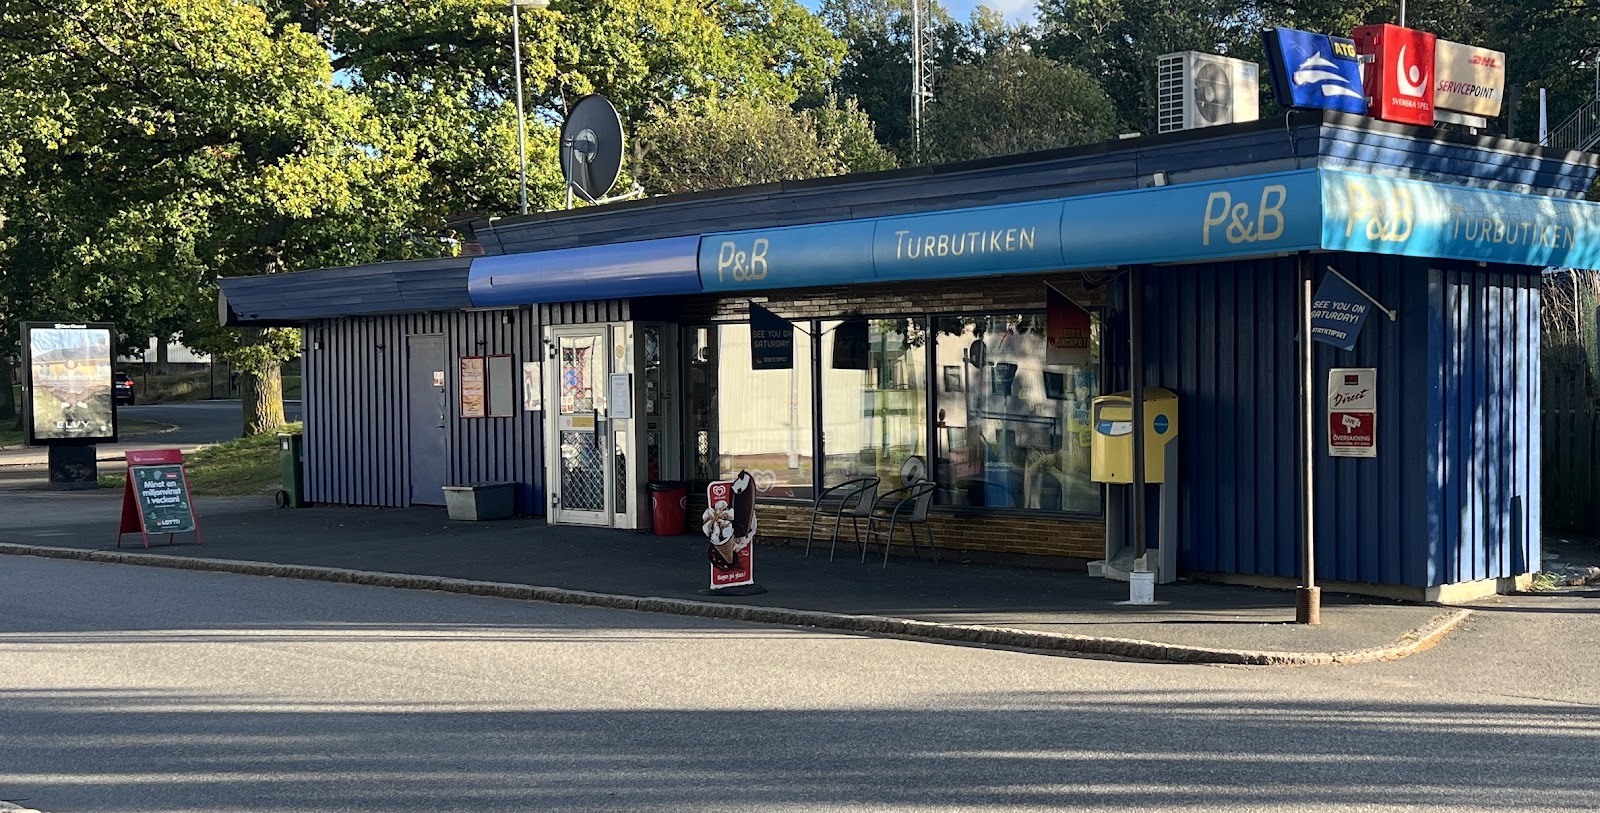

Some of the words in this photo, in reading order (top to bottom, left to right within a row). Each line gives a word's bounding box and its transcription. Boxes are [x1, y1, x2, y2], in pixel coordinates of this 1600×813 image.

[1334, 42, 1357, 58] ATG
[1469, 55, 1500, 69] DHL
[1437, 79, 1494, 99] SERVICEPOINT
[1392, 97, 1417, 109] SVENSKA
[1417, 100, 1430, 111] SPEL
[1202, 184, 1288, 247] P&B
[1345, 182, 1414, 243] P&B
[1450, 205, 1578, 251] TURBUTIKEN
[895, 226, 1037, 261] TURBUTIKEN
[717, 237, 770, 284] P&B
[1313, 300, 1330, 308] SEE
[1332, 302, 1350, 310] YOU
[1352, 304, 1366, 314] ON
[1310, 310, 1359, 324] SATURDAY!
[783, 330, 792, 338] ON
[1334, 388, 1370, 407] Direct
[142, 488, 181, 497] miljonvinst
